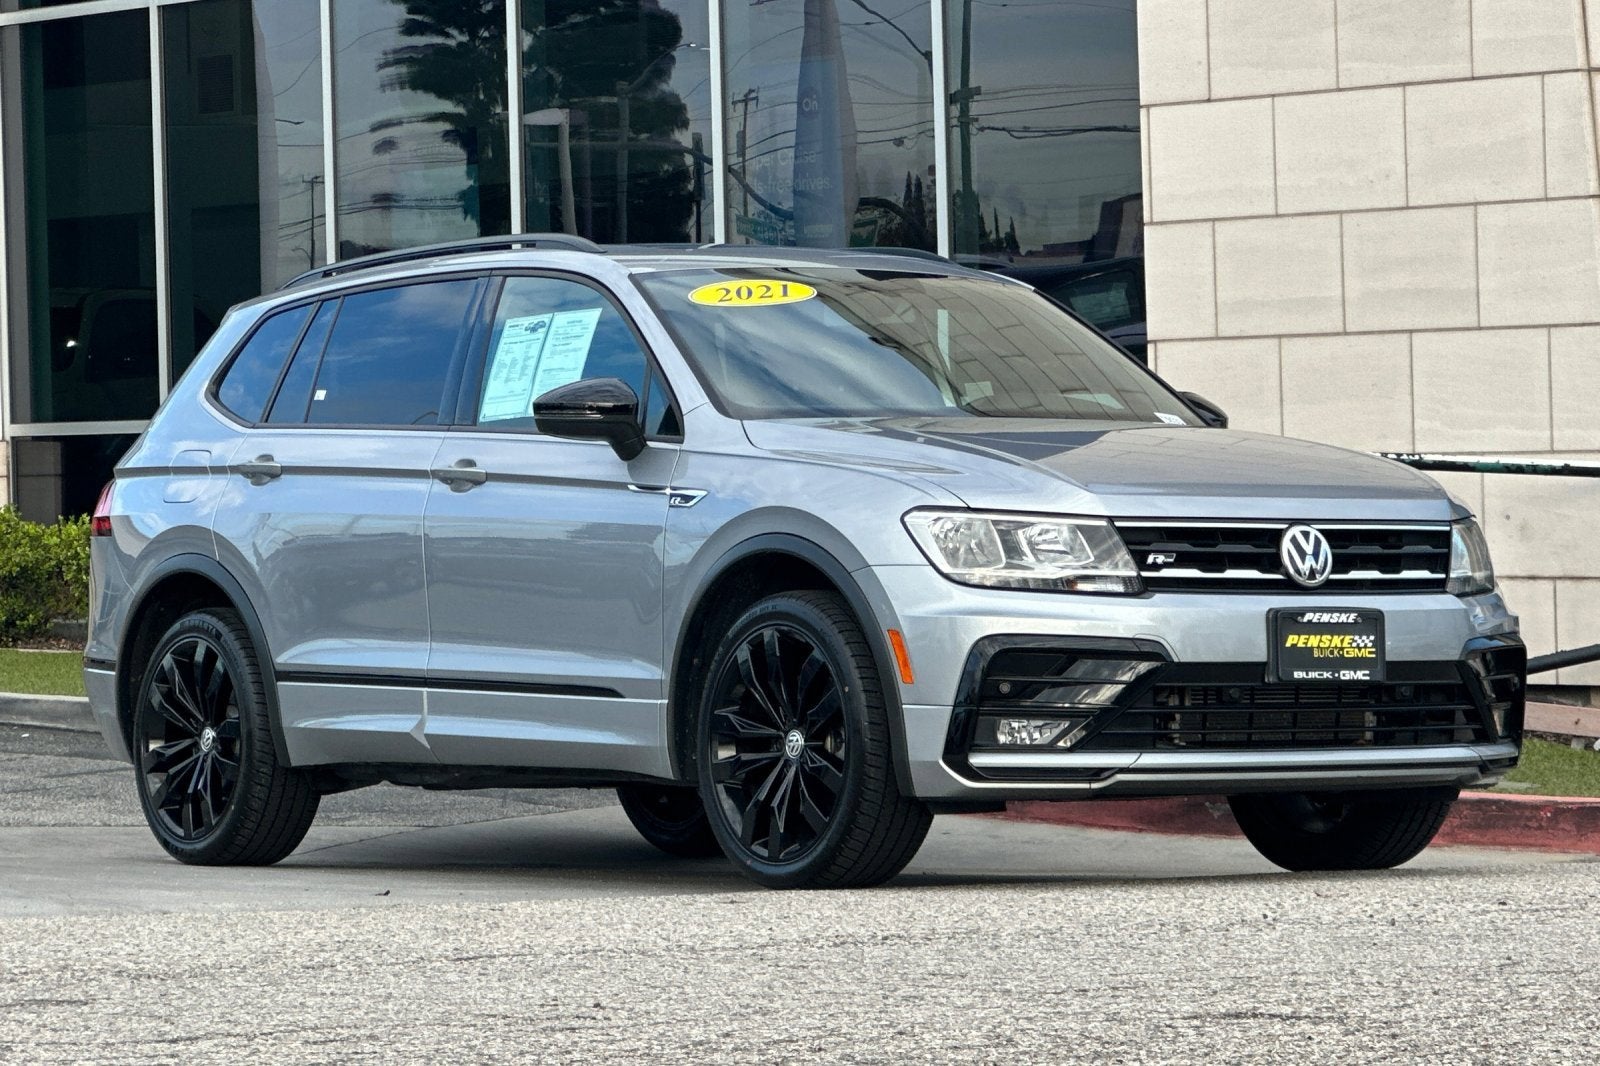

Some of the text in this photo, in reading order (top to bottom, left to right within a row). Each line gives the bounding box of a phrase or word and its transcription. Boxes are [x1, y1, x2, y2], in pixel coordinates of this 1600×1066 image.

[715, 284, 789, 303] 2021
[1302, 612, 1358, 623] PENSKE
[1285, 634, 1355, 648] PENSKE
